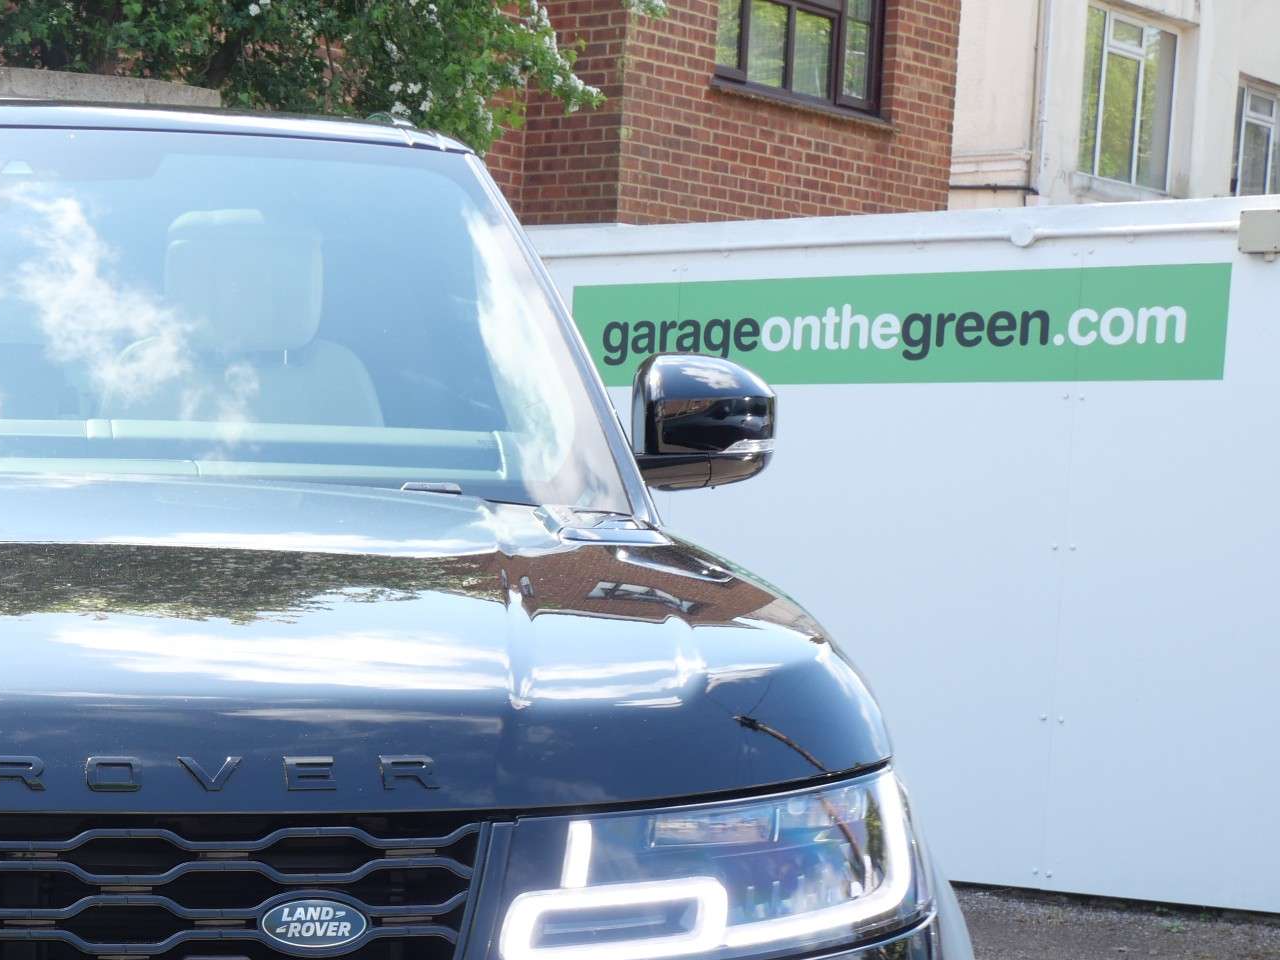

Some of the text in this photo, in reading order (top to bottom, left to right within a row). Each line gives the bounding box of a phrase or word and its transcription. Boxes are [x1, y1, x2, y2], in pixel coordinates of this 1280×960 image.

[602, 303, 1187, 366] garageonthegreen.com
[281, 906, 333, 922] LAND
[287, 922, 351, 938] ROVER
